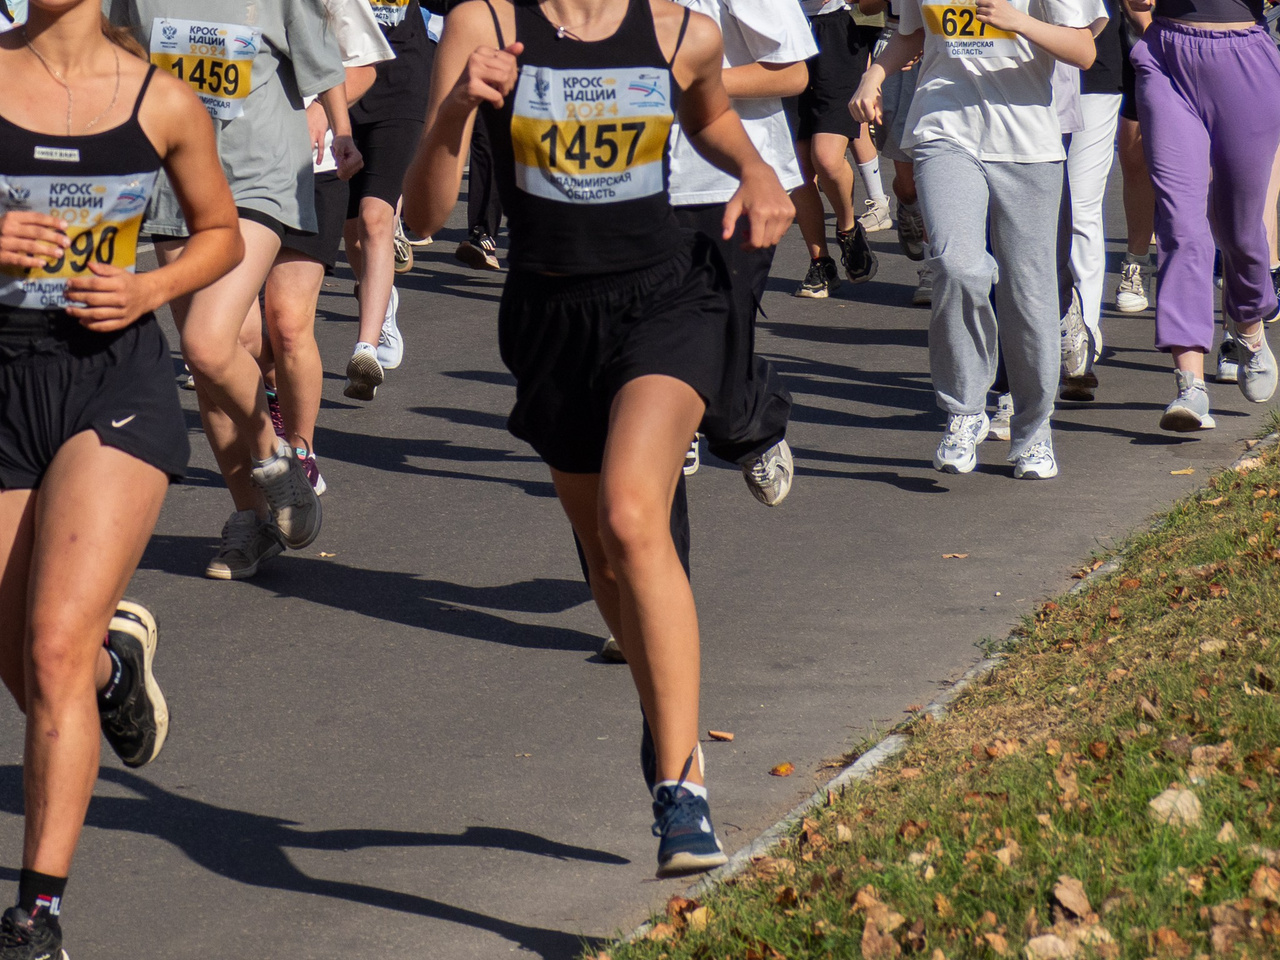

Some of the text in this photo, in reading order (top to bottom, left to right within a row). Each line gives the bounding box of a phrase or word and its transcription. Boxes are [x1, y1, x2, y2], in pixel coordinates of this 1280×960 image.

[189, 26, 218, 36] КРОСС
[189, 35, 225, 46] НАЦИИ
[190, 44, 226, 57] 2024
[952, 48, 983, 56] ОБЛАСТЬ
[171, 57, 239, 95] 1459
[563, 77, 603, 88] КРОСС
[564, 89, 616, 102] НАЦИИ
[200, 96, 231, 109] МИРСКАЯ
[565, 102, 619, 118] 2024
[541, 121, 646, 170] 1457
[49, 183, 93, 195] КРОСС
[566, 189, 616, 200] ОБЛАСТЬ
[49, 197, 104, 209] НАЦИИ
[35, 894, 61, 916] FIL
